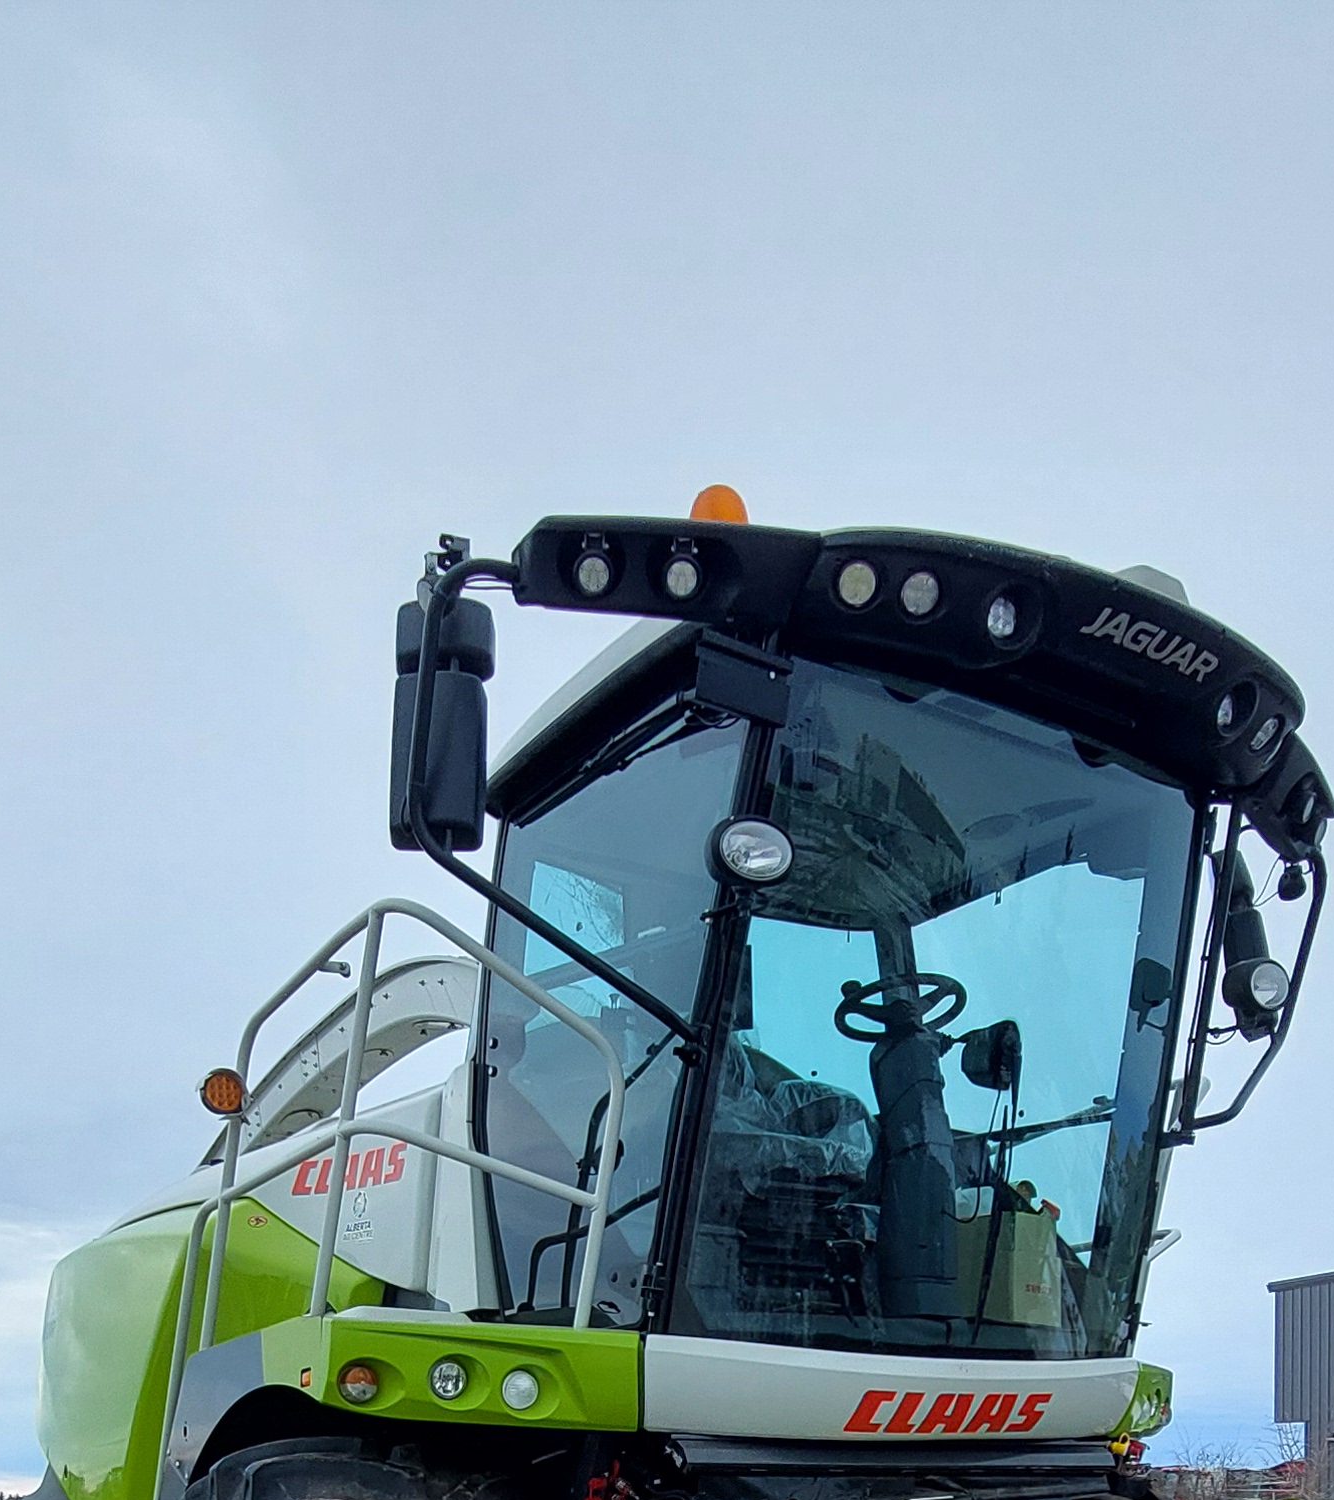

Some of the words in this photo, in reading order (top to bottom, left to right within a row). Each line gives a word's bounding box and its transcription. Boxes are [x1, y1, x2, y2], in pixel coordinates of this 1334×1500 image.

[1079, 607, 1219, 683] JAGUAR
[291, 1141, 408, 1197] CLAAS
[346, 1219, 372, 1232] ALBERTA
[843, 1389, 1053, 1434] CLAAS
